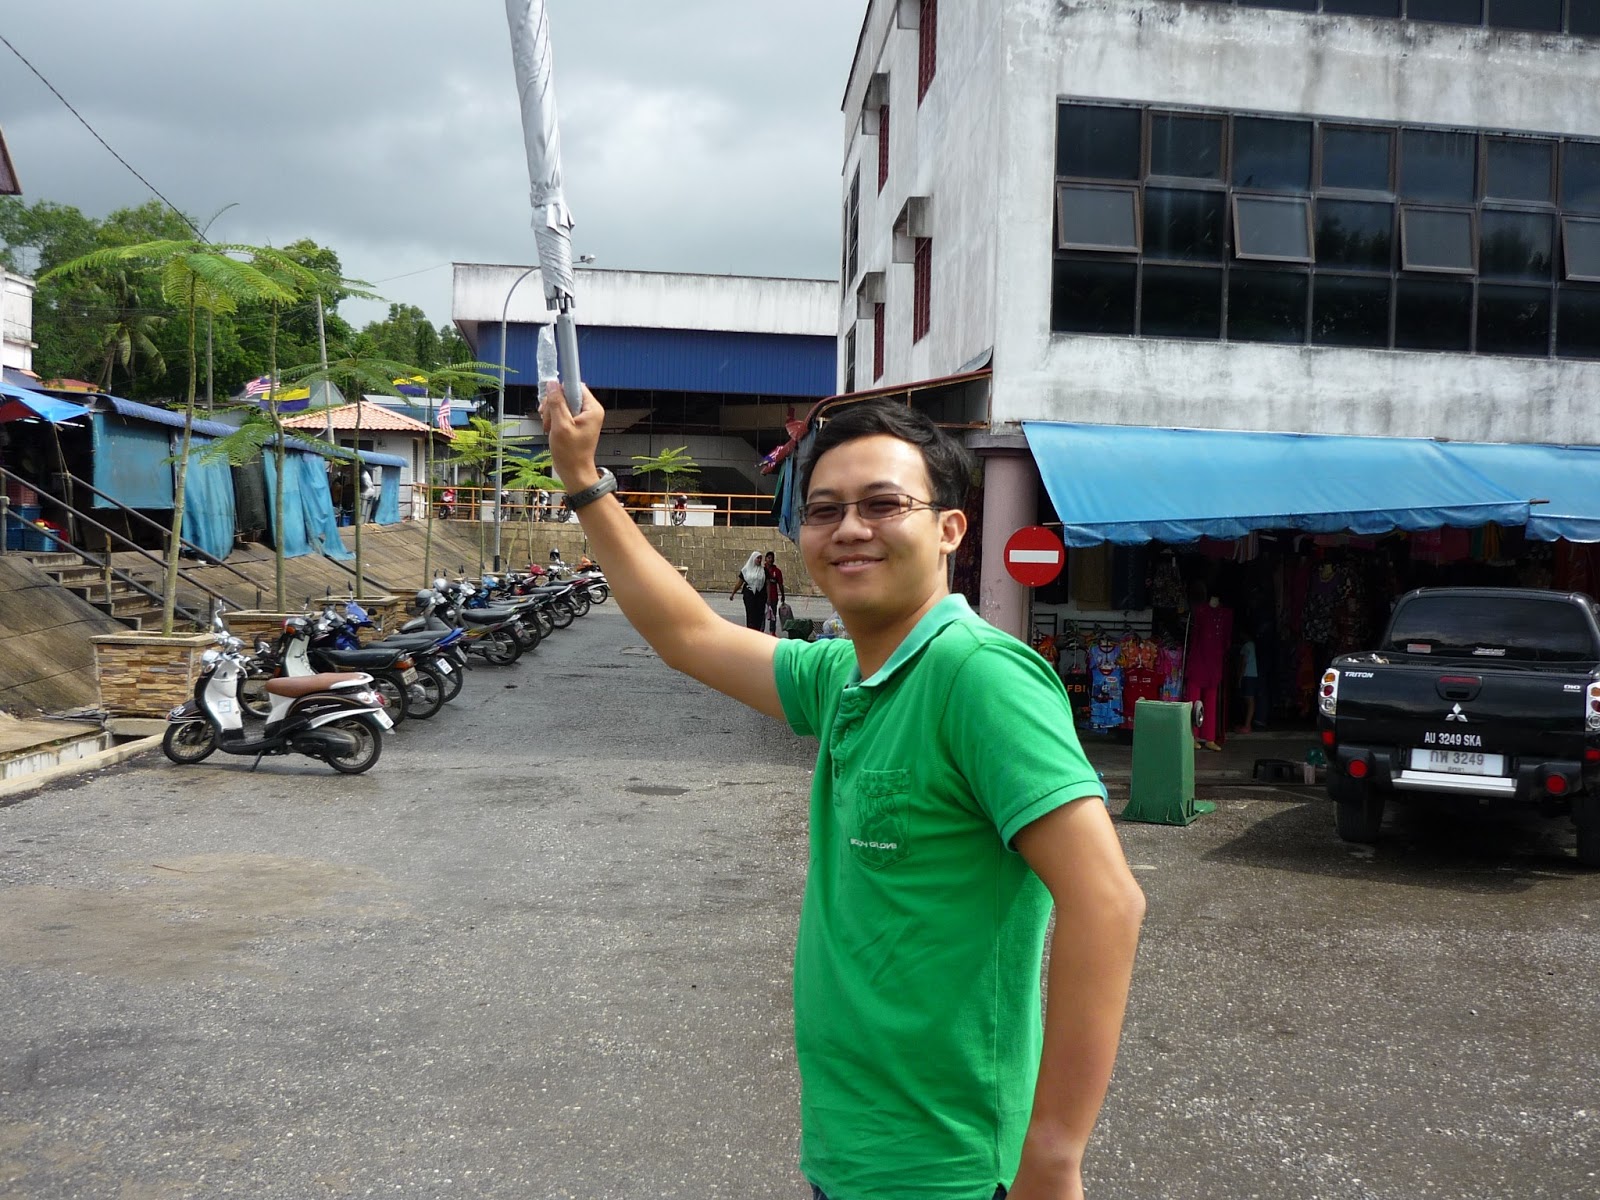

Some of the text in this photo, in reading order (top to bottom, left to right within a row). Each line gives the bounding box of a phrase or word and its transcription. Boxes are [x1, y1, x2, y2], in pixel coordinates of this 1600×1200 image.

[1344, 671, 1374, 679] TRITON
[1067, 684, 1086, 693] FBI
[1424, 732, 1482, 747] AU 3249 SKA
[1453, 752, 1484, 766] 3249
